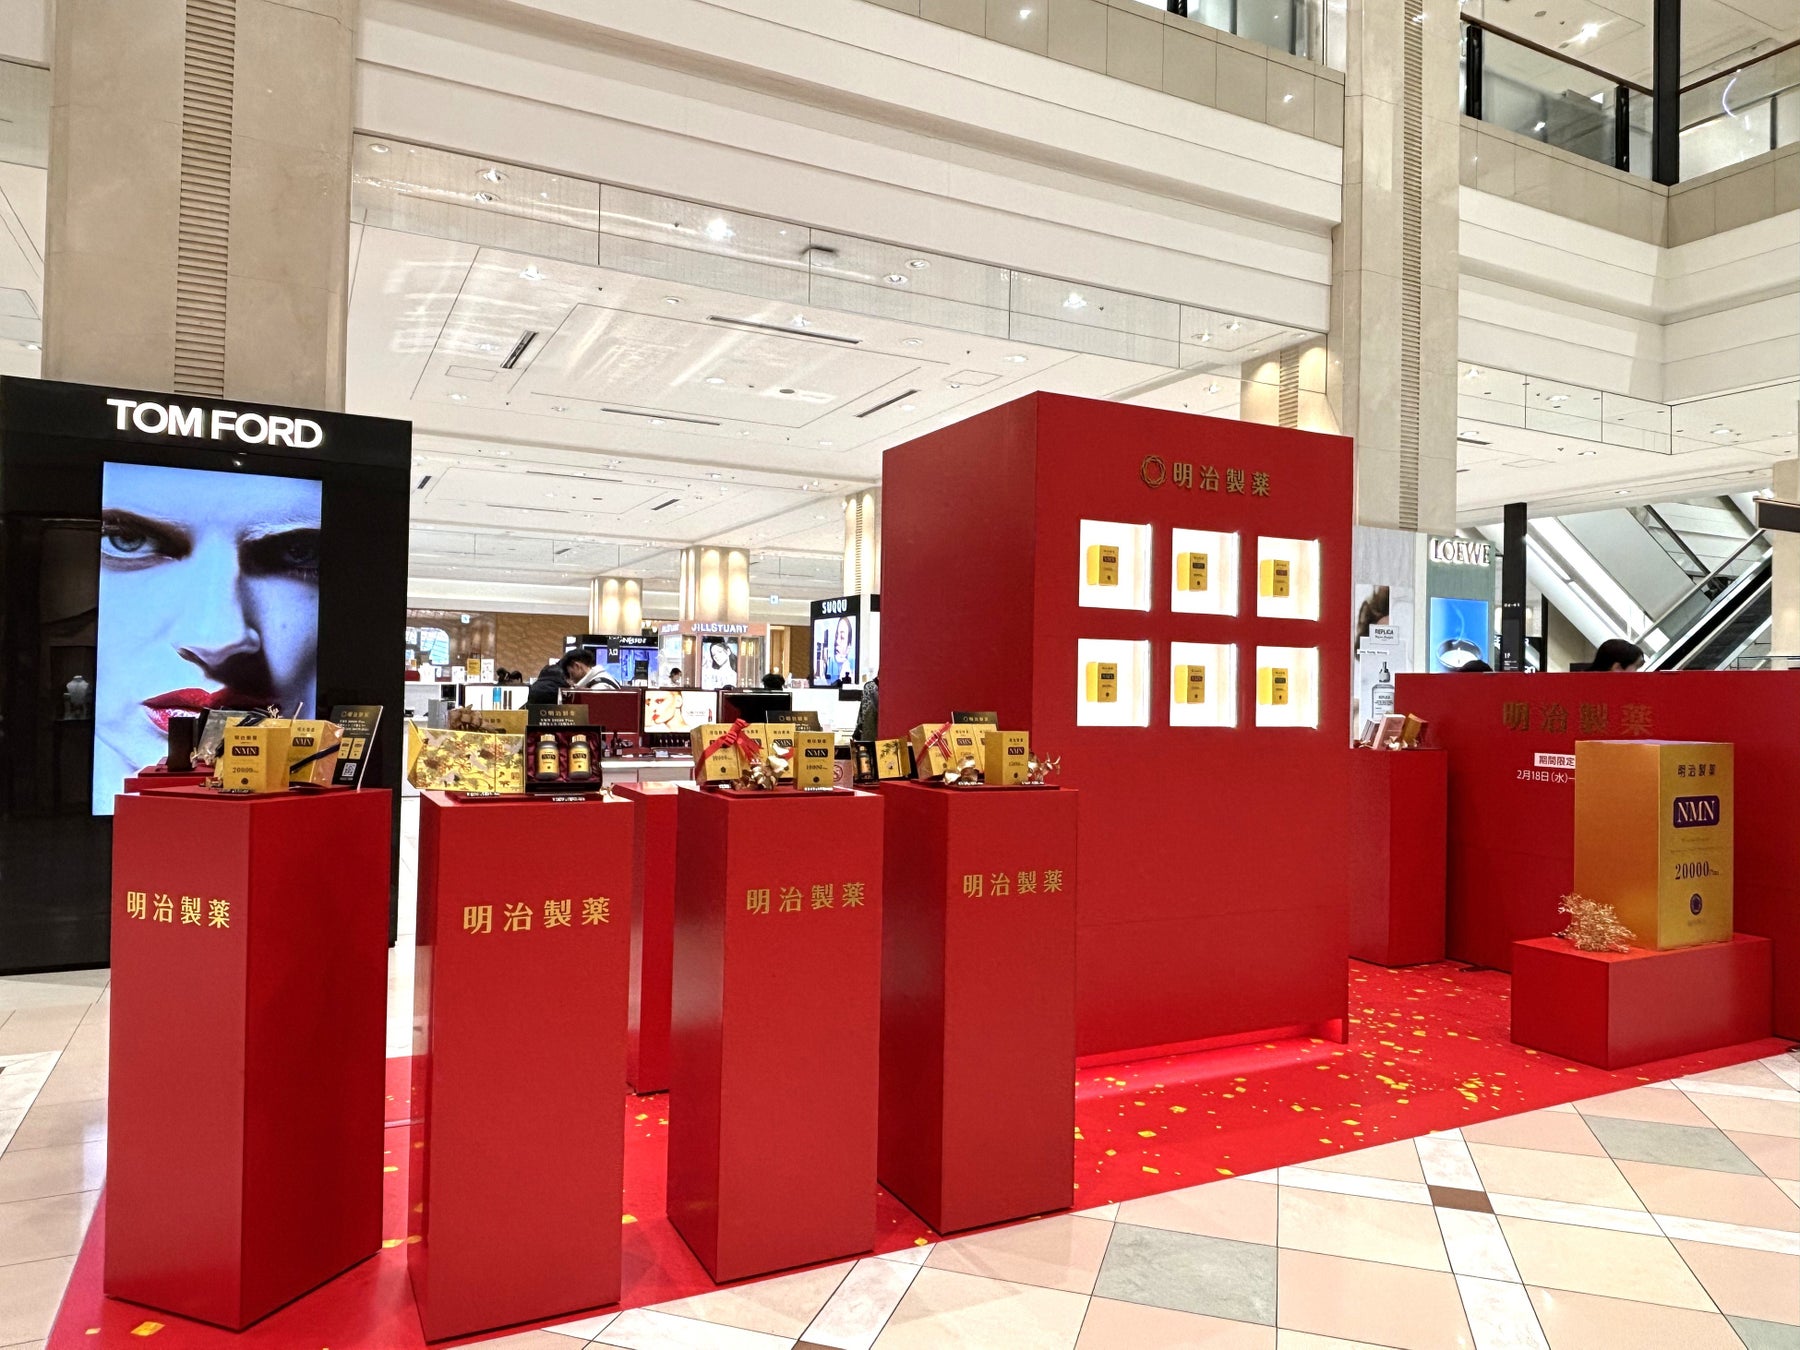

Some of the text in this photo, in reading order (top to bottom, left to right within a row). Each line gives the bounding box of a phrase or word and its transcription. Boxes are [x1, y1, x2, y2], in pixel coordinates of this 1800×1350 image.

[106, 398, 324, 449] TOM FORD
[1172, 461, 1270, 497] 明治製薬
[1431, 539, 1491, 566] LOEWE
[821, 599, 848, 615] SUQQU
[1374, 628, 1394, 636] REPLICA
[1502, 702, 1653, 736] 明治製薬
[234, 747, 258, 755] NMN
[806, 749, 828, 757] NMN
[1538, 755, 1575, 767] 期間限定
[1677, 763, 1717, 778] 明治製薬
[1677, 800, 1716, 823] NMN
[963, 869, 1064, 899] 明治製薬
[126, 890, 232, 929] 明治製薬
[746, 882, 866, 915] 明治製薬
[462, 896, 612, 934] 明治製薬
